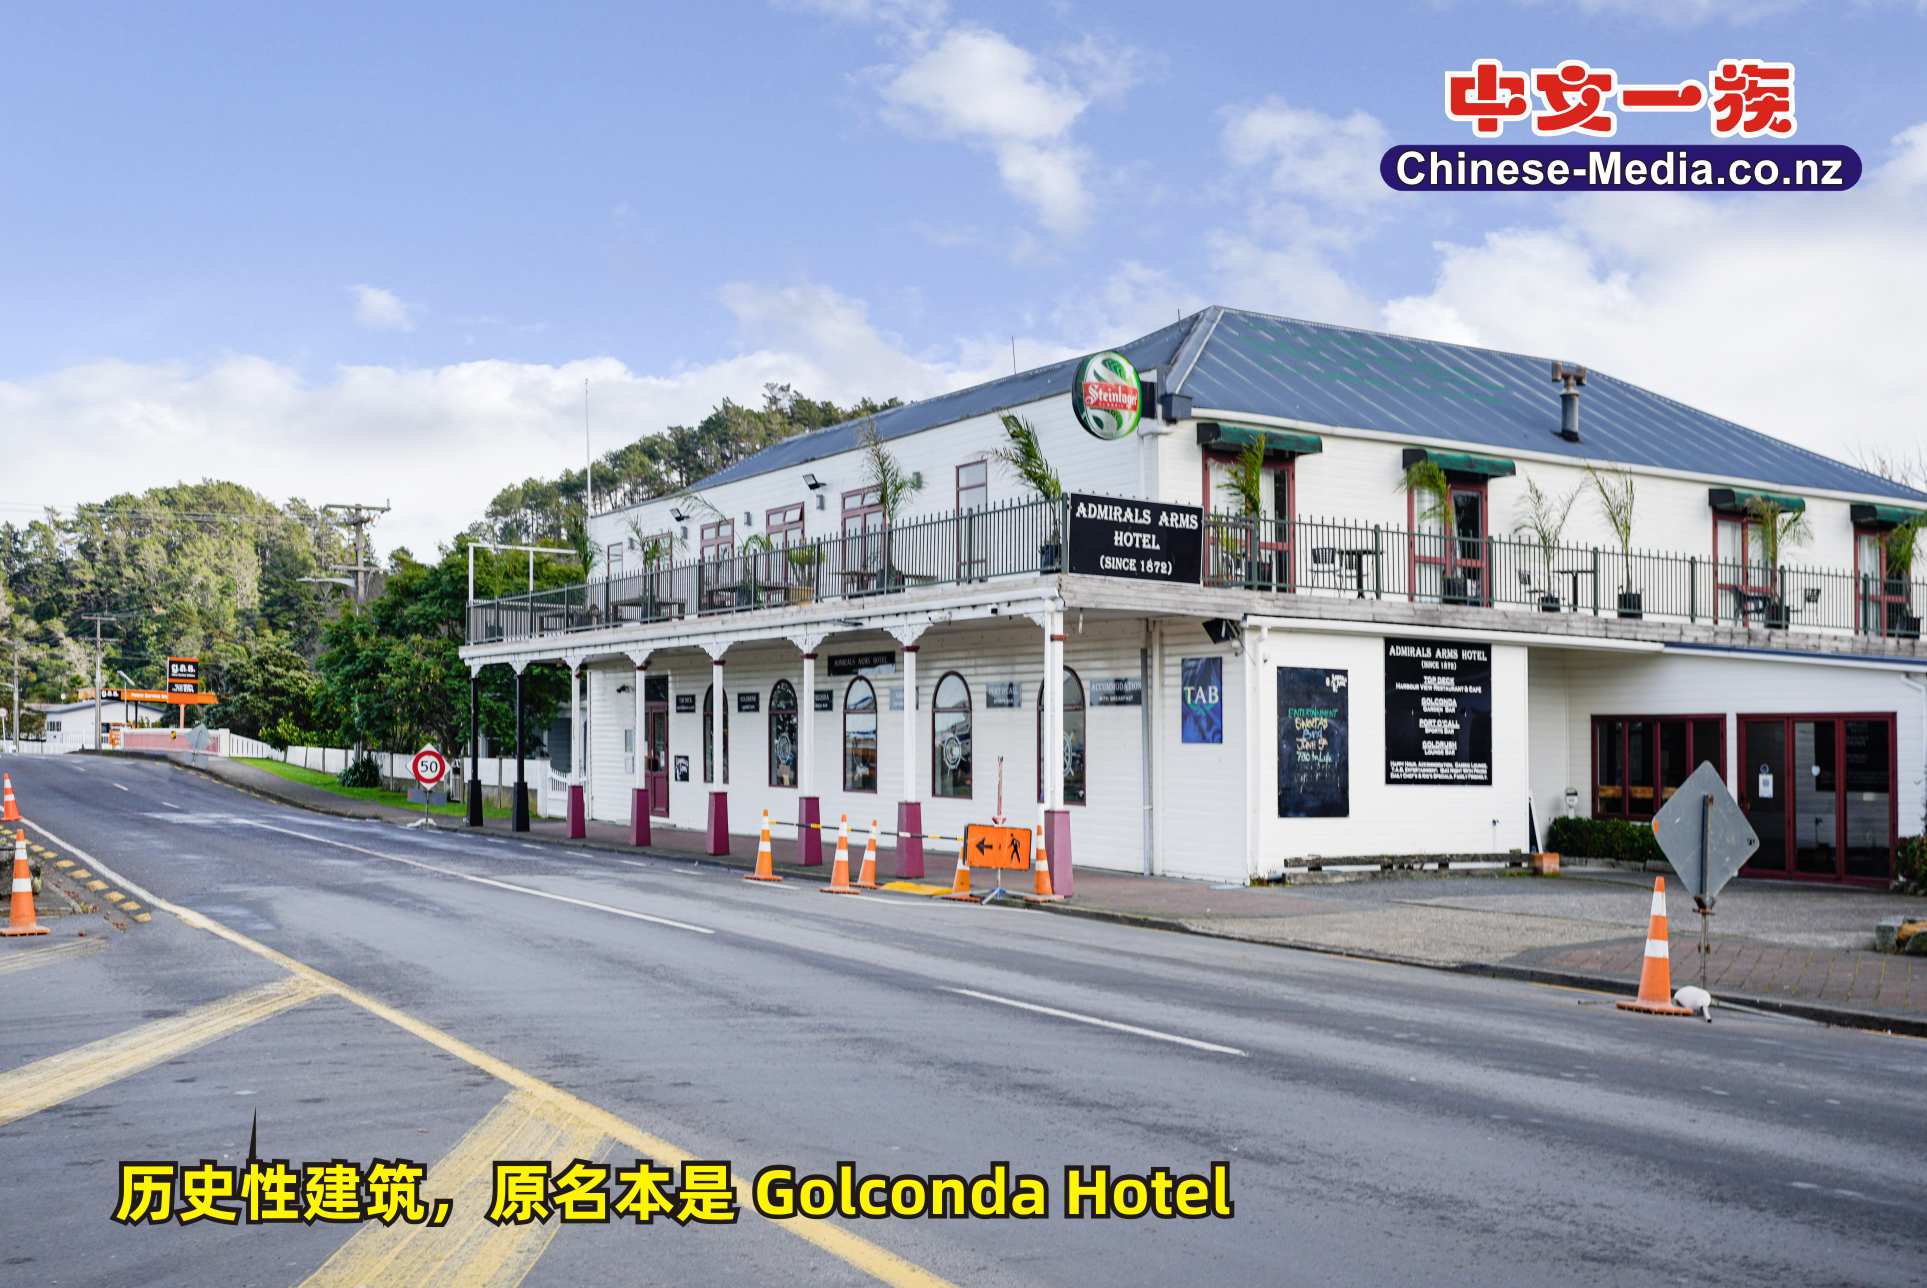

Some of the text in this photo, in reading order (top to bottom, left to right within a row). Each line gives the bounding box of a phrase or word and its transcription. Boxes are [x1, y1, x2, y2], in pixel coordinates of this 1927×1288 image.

[1075, 502, 1199, 530] ADMIRALS ARMS
[1113, 530, 1161, 550] HOTEL
[1099, 555, 1173, 576] (SINCE 1872)
[1389, 645, 1488, 662] ADMIRALS ARMS HOTEL
[1184, 685, 1219, 705] TAB
[420, 760, 438, 773] 50
